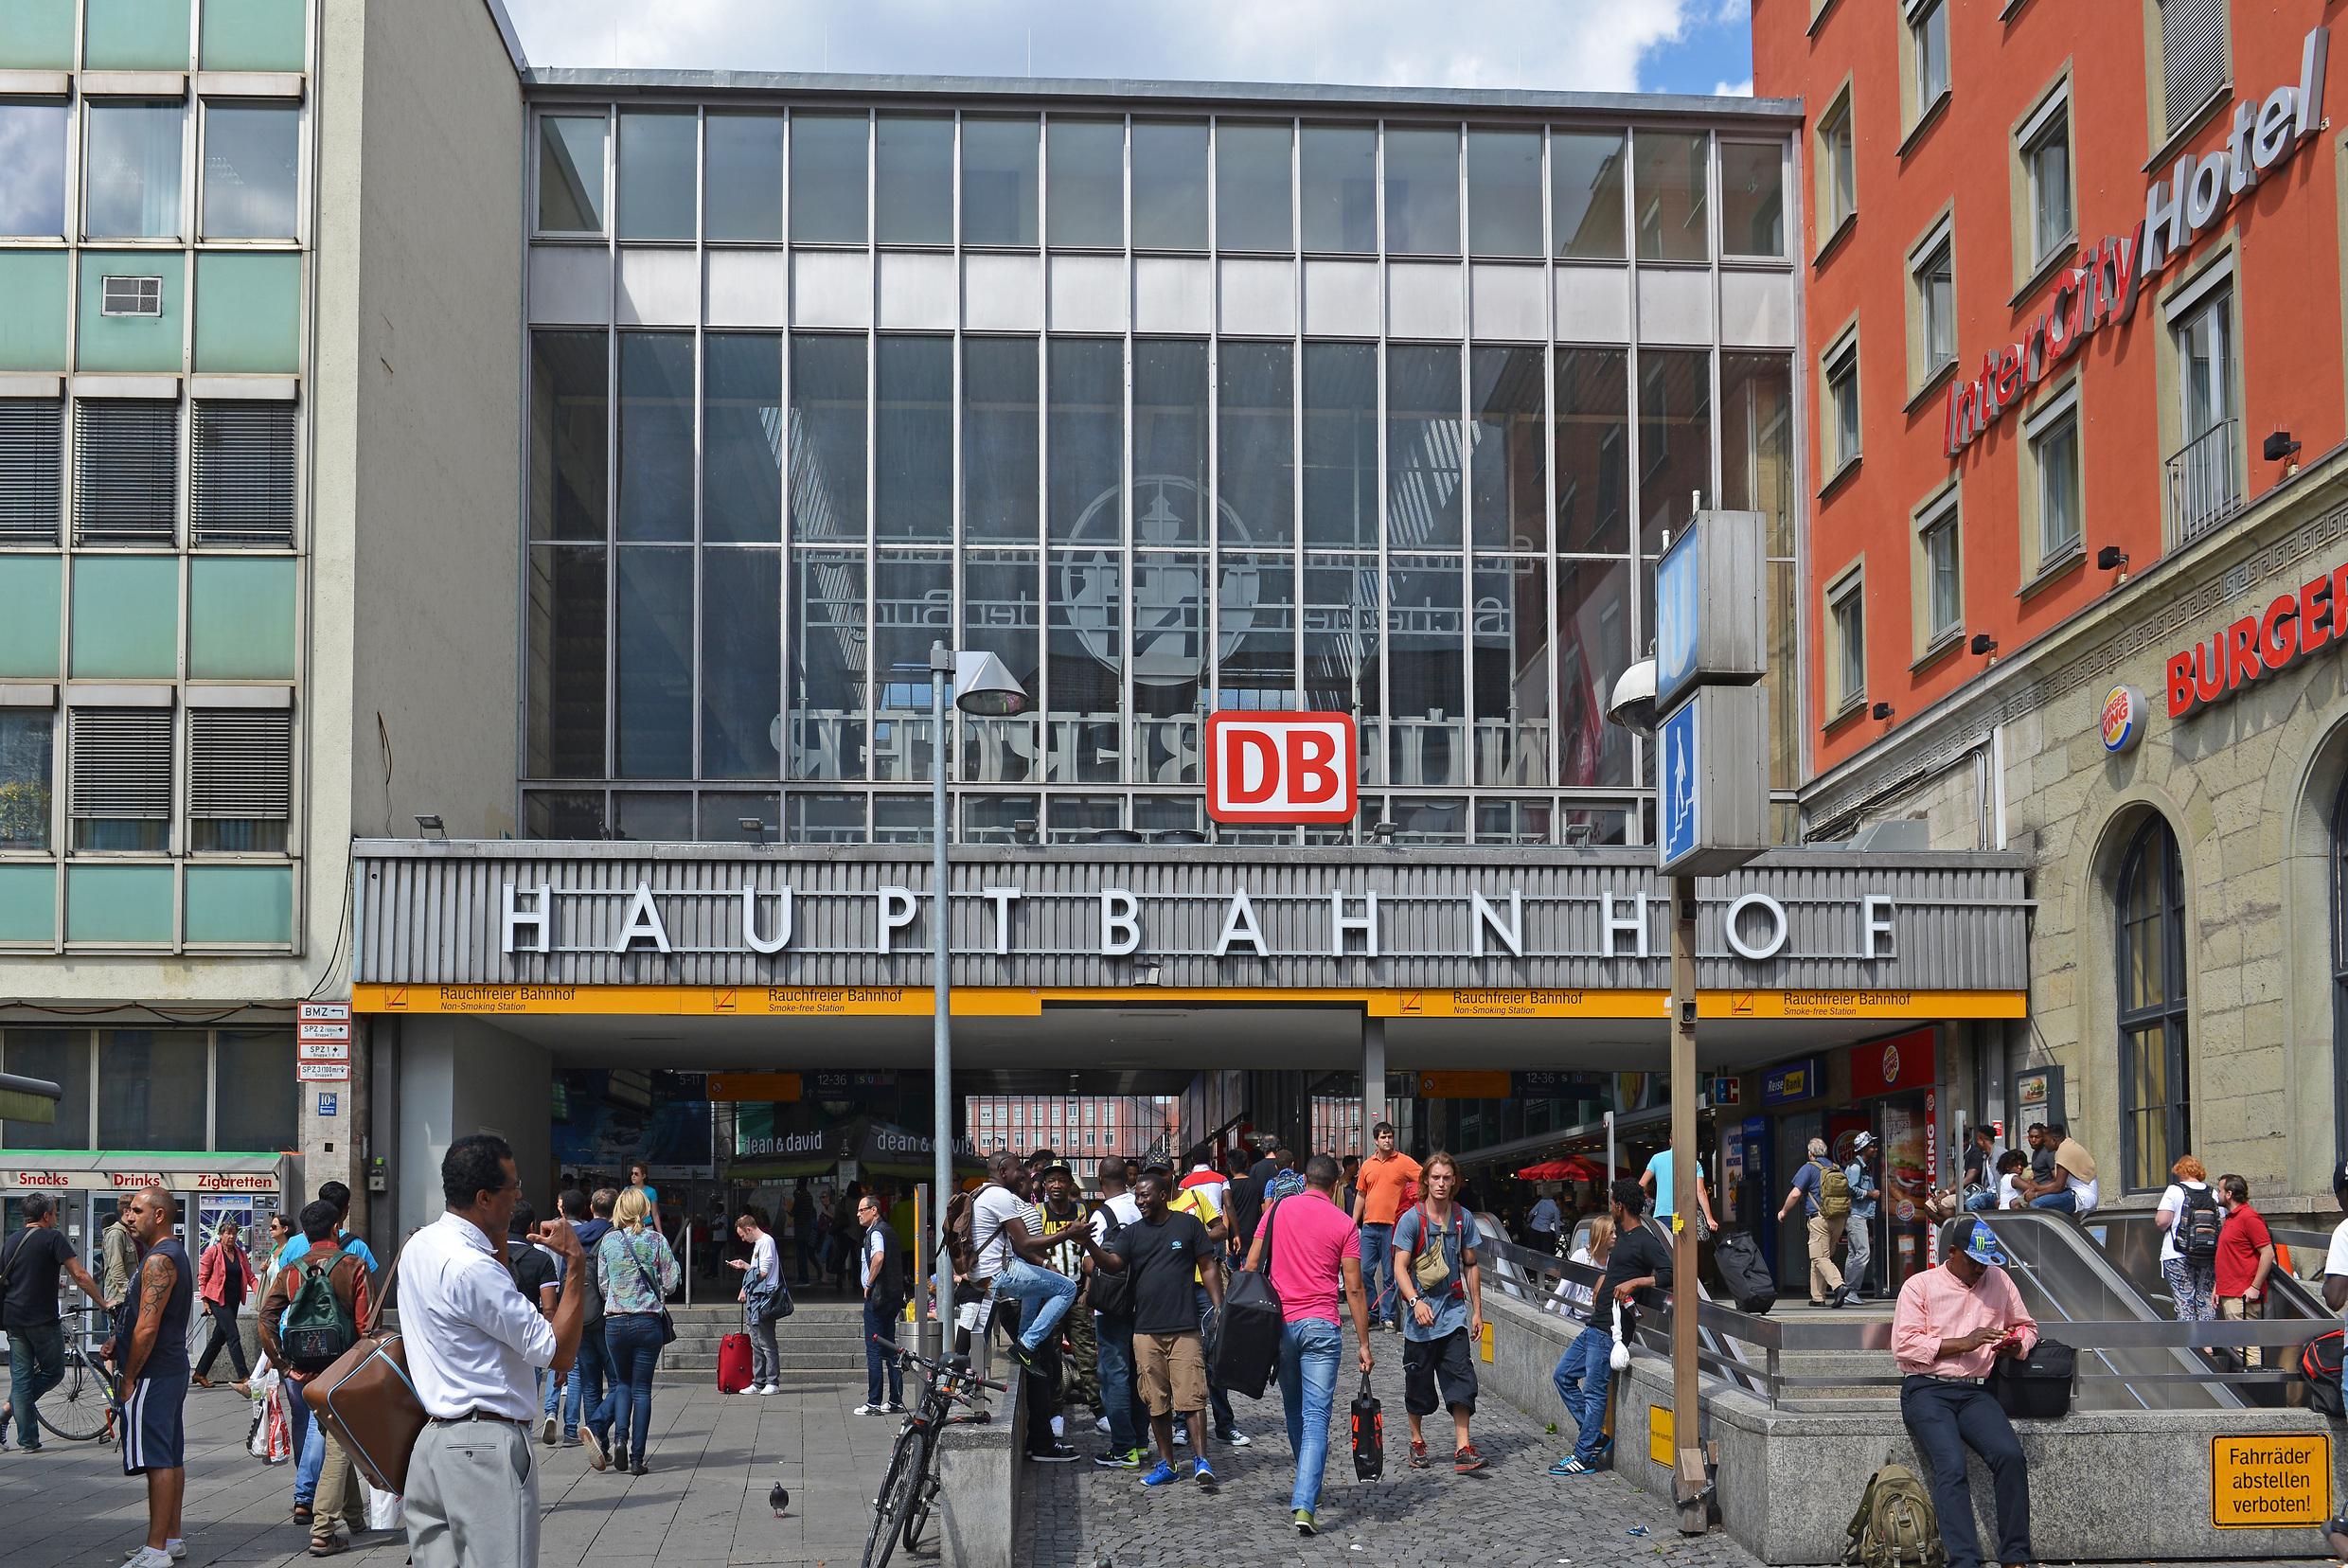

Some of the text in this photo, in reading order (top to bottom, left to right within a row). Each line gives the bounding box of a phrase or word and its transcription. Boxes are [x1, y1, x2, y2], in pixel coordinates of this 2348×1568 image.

[1663, 546, 1691, 679] U
[2102, 691, 2127, 728] BURGER
[2103, 703, 2127, 742] KING
[1225, 729, 1340, 804] DB
[440, 987, 577, 1001] Rauchfreier Bahnhof
[768, 989, 902, 1003] Rauchfreier Bahnhof
[1453, 990, 1584, 1005] Rauchfreier Bahnhof
[1784, 992, 1911, 1007] Rauchfreier Bahnhof
[305, 1007, 328, 1017] BMZ
[440, 1002, 526, 1012] Non-Smoking Station
[768, 1004, 845, 1012] Smoke-free Station
[1453, 1006, 1536, 1016] Non-Smoking Station
[1784, 1007, 1857, 1016] Smoke-free Station
[817, 1074, 847, 1086] 12-36
[1526, 1073, 1555, 1084] 12-36
[1767, 1075, 1802, 1093] Reise Bank
[743, 1130, 822, 1155] dean & david
[877, 1131, 916, 1151] dean
[920, 1137, 930, 1152] &
[19, 1172, 69, 1185] Snacks
[114, 1173, 160, 1186] Drinks
[197, 1174, 273, 1190] Zigaretten
[2230, 1447, 2311, 1465] Fahrräder
[2232, 1471, 2310, 1489] abstellen
[2232, 1495, 2310, 1513] verboten!
